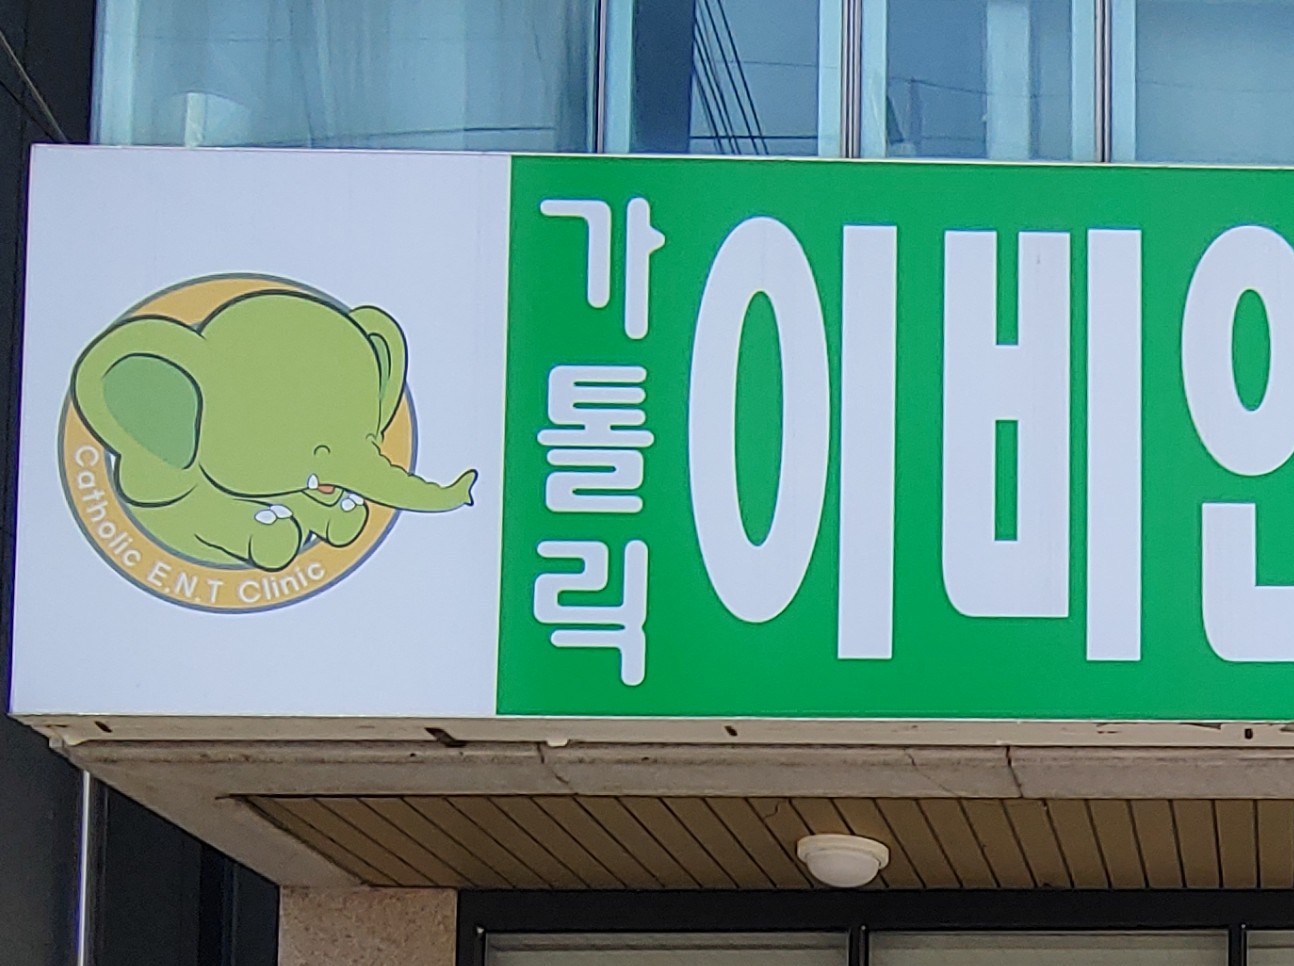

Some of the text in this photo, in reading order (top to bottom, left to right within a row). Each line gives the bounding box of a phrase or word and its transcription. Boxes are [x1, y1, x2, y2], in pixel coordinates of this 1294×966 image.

[75, 445, 141, 567] Catholic
[238, 562, 325, 603] Clinic
[534, 197, 665, 686] 가톨릭
